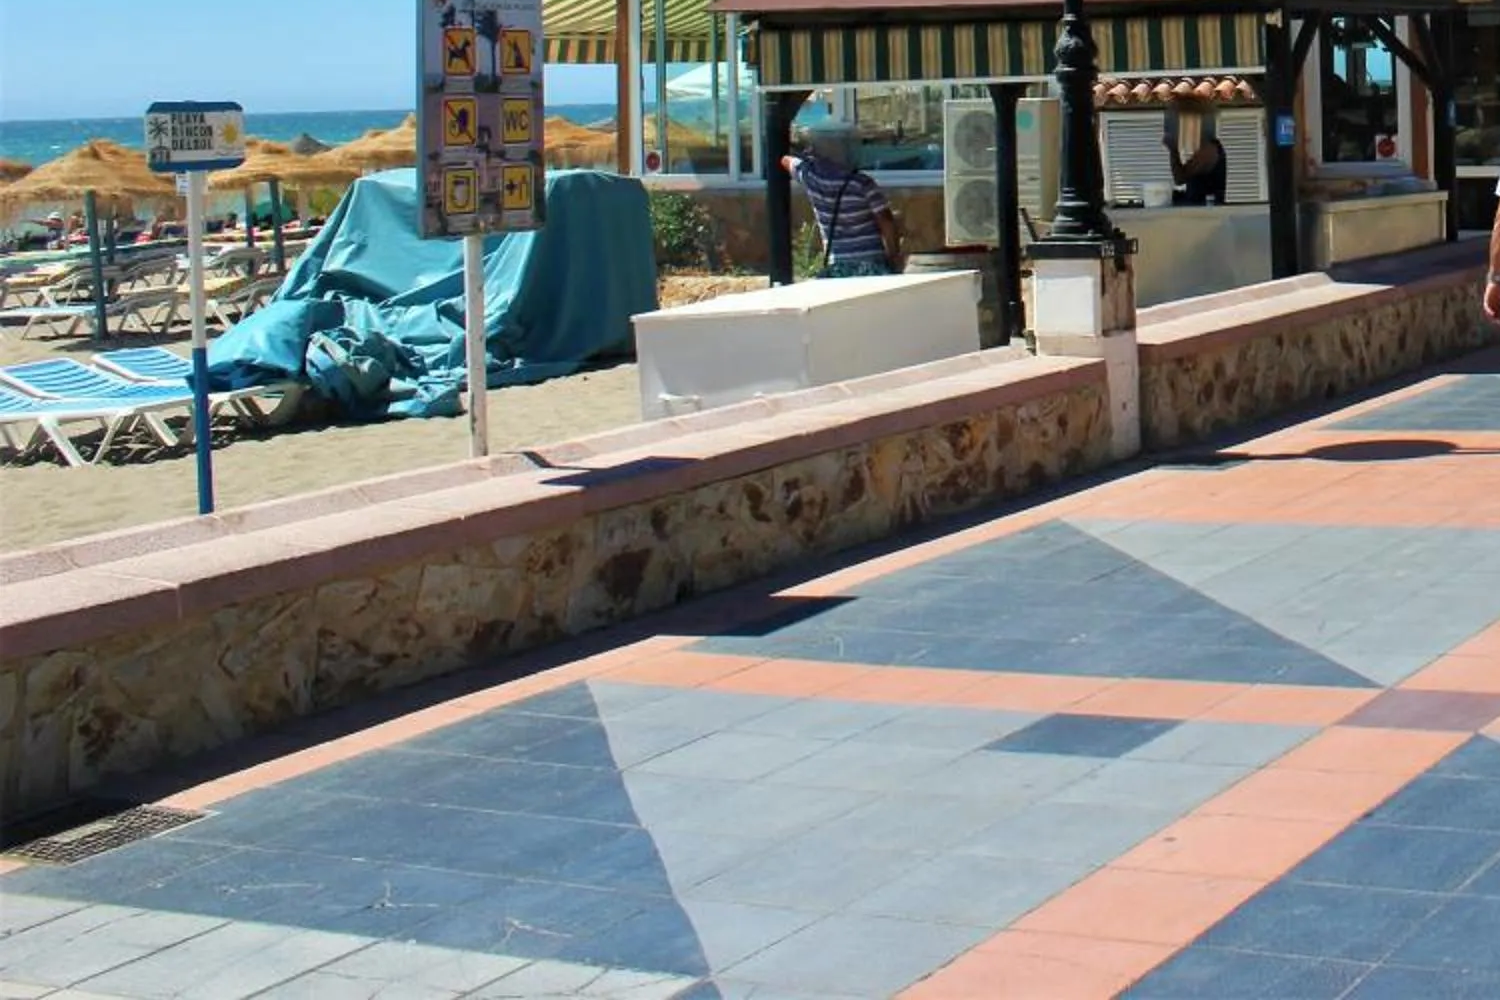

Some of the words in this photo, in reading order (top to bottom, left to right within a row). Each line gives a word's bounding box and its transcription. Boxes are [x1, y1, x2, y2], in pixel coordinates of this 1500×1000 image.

[171, 113, 205, 124] PLAYA
[504, 110, 529, 132] WC
[171, 125, 213, 137] RINCON
